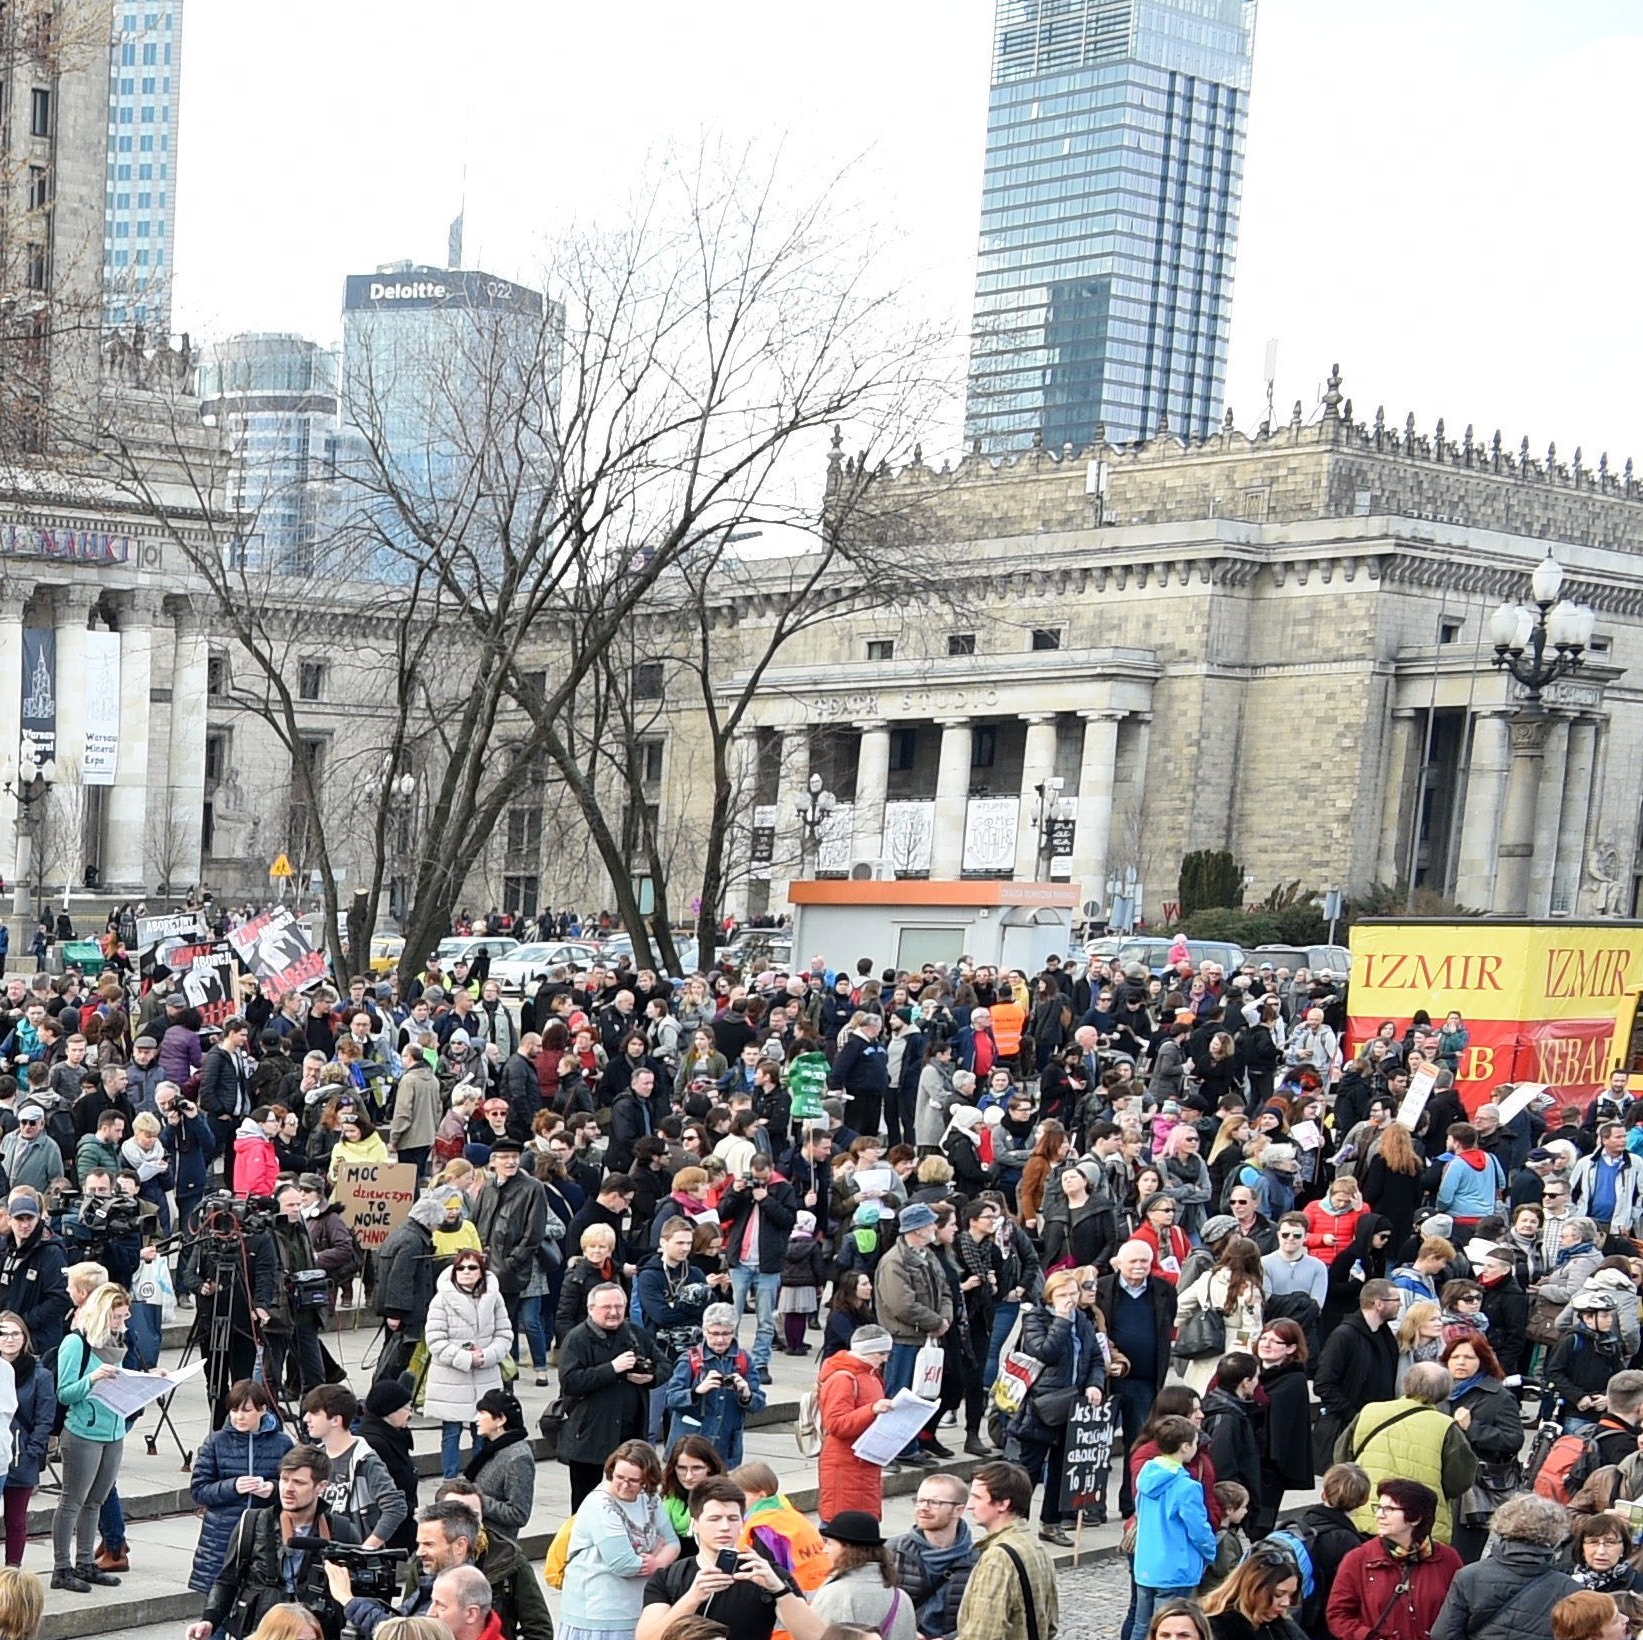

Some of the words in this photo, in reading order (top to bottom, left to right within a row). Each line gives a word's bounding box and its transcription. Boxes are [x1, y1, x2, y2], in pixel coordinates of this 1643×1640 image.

[370, 282, 446, 300] Deloitte
[37, 527, 131, 562] NAUKI
[814, 694, 879, 717] TEATR
[901, 689, 1000, 711] STUDIO
[85, 743, 115, 755] Mineral
[84, 755, 105, 767] Expo
[1361, 953, 1504, 991] IZMIR
[1544, 948, 1637, 998] IZMIR
[347, 1166, 378, 1182] MOC
[352, 1184, 413, 1203] dziewczyn
[368, 1200, 386, 1212] TO
[354, 1212, 391, 1227] NOWE
